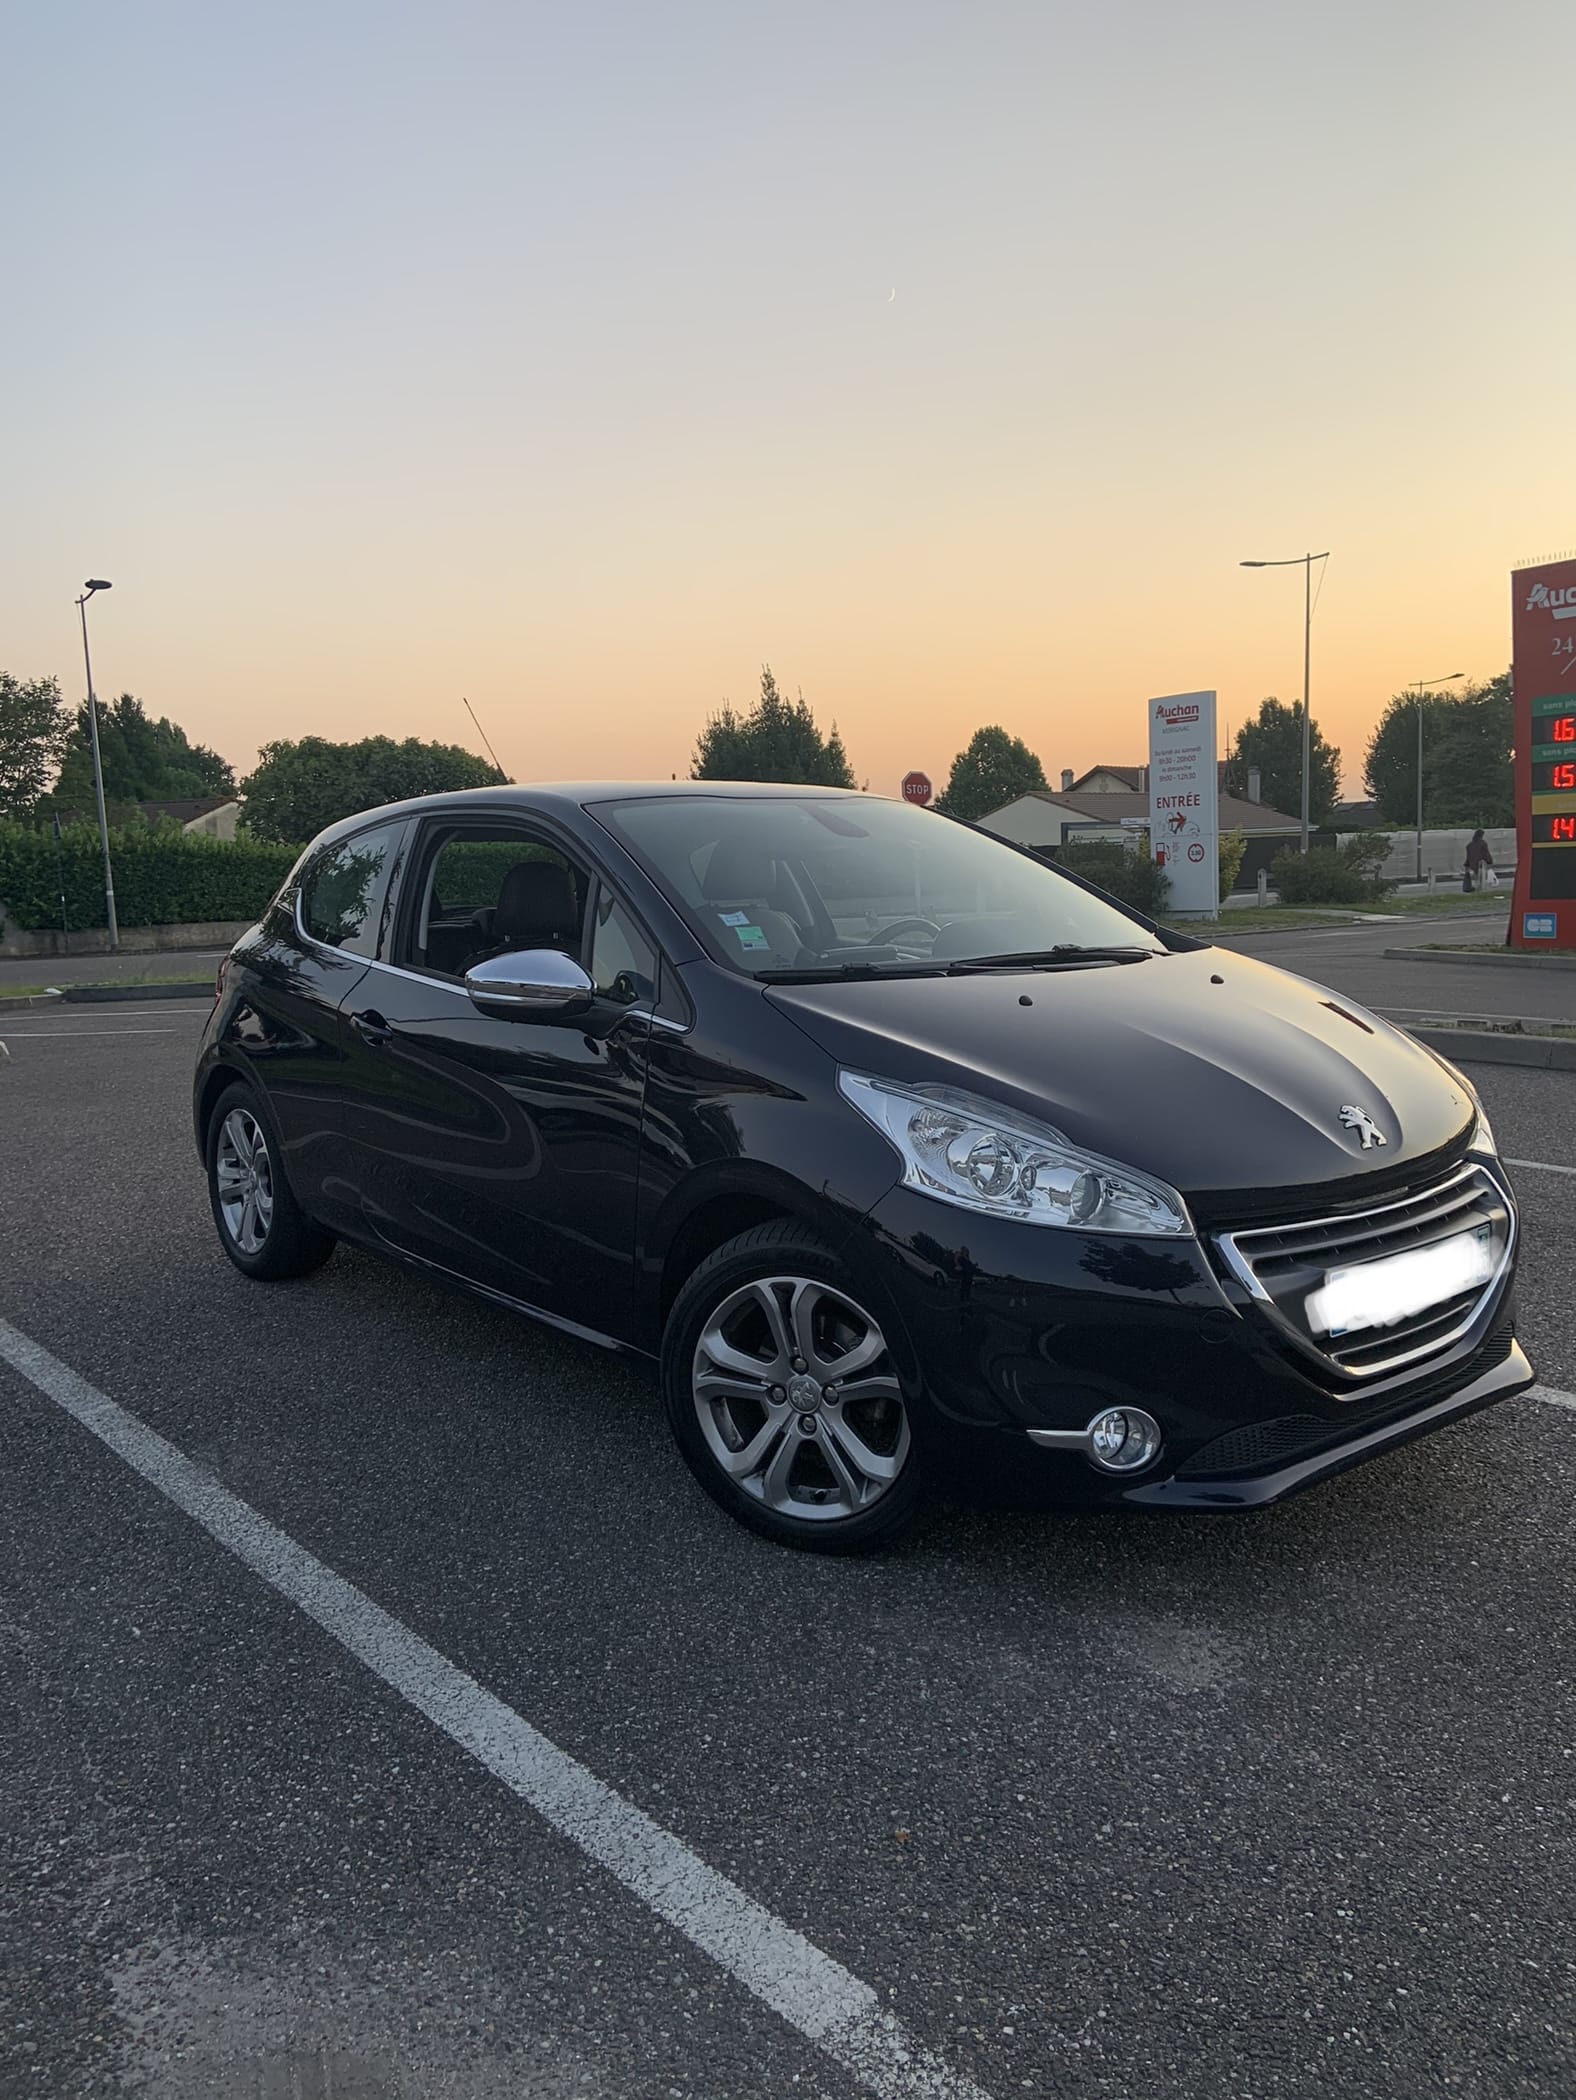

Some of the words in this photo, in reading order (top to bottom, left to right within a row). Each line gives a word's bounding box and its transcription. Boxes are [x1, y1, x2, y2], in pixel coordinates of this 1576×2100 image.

[1155, 704, 1200, 719] Auchan
[906, 784, 929, 795] STOP
[1156, 791, 1201, 809] ENTRÉE
